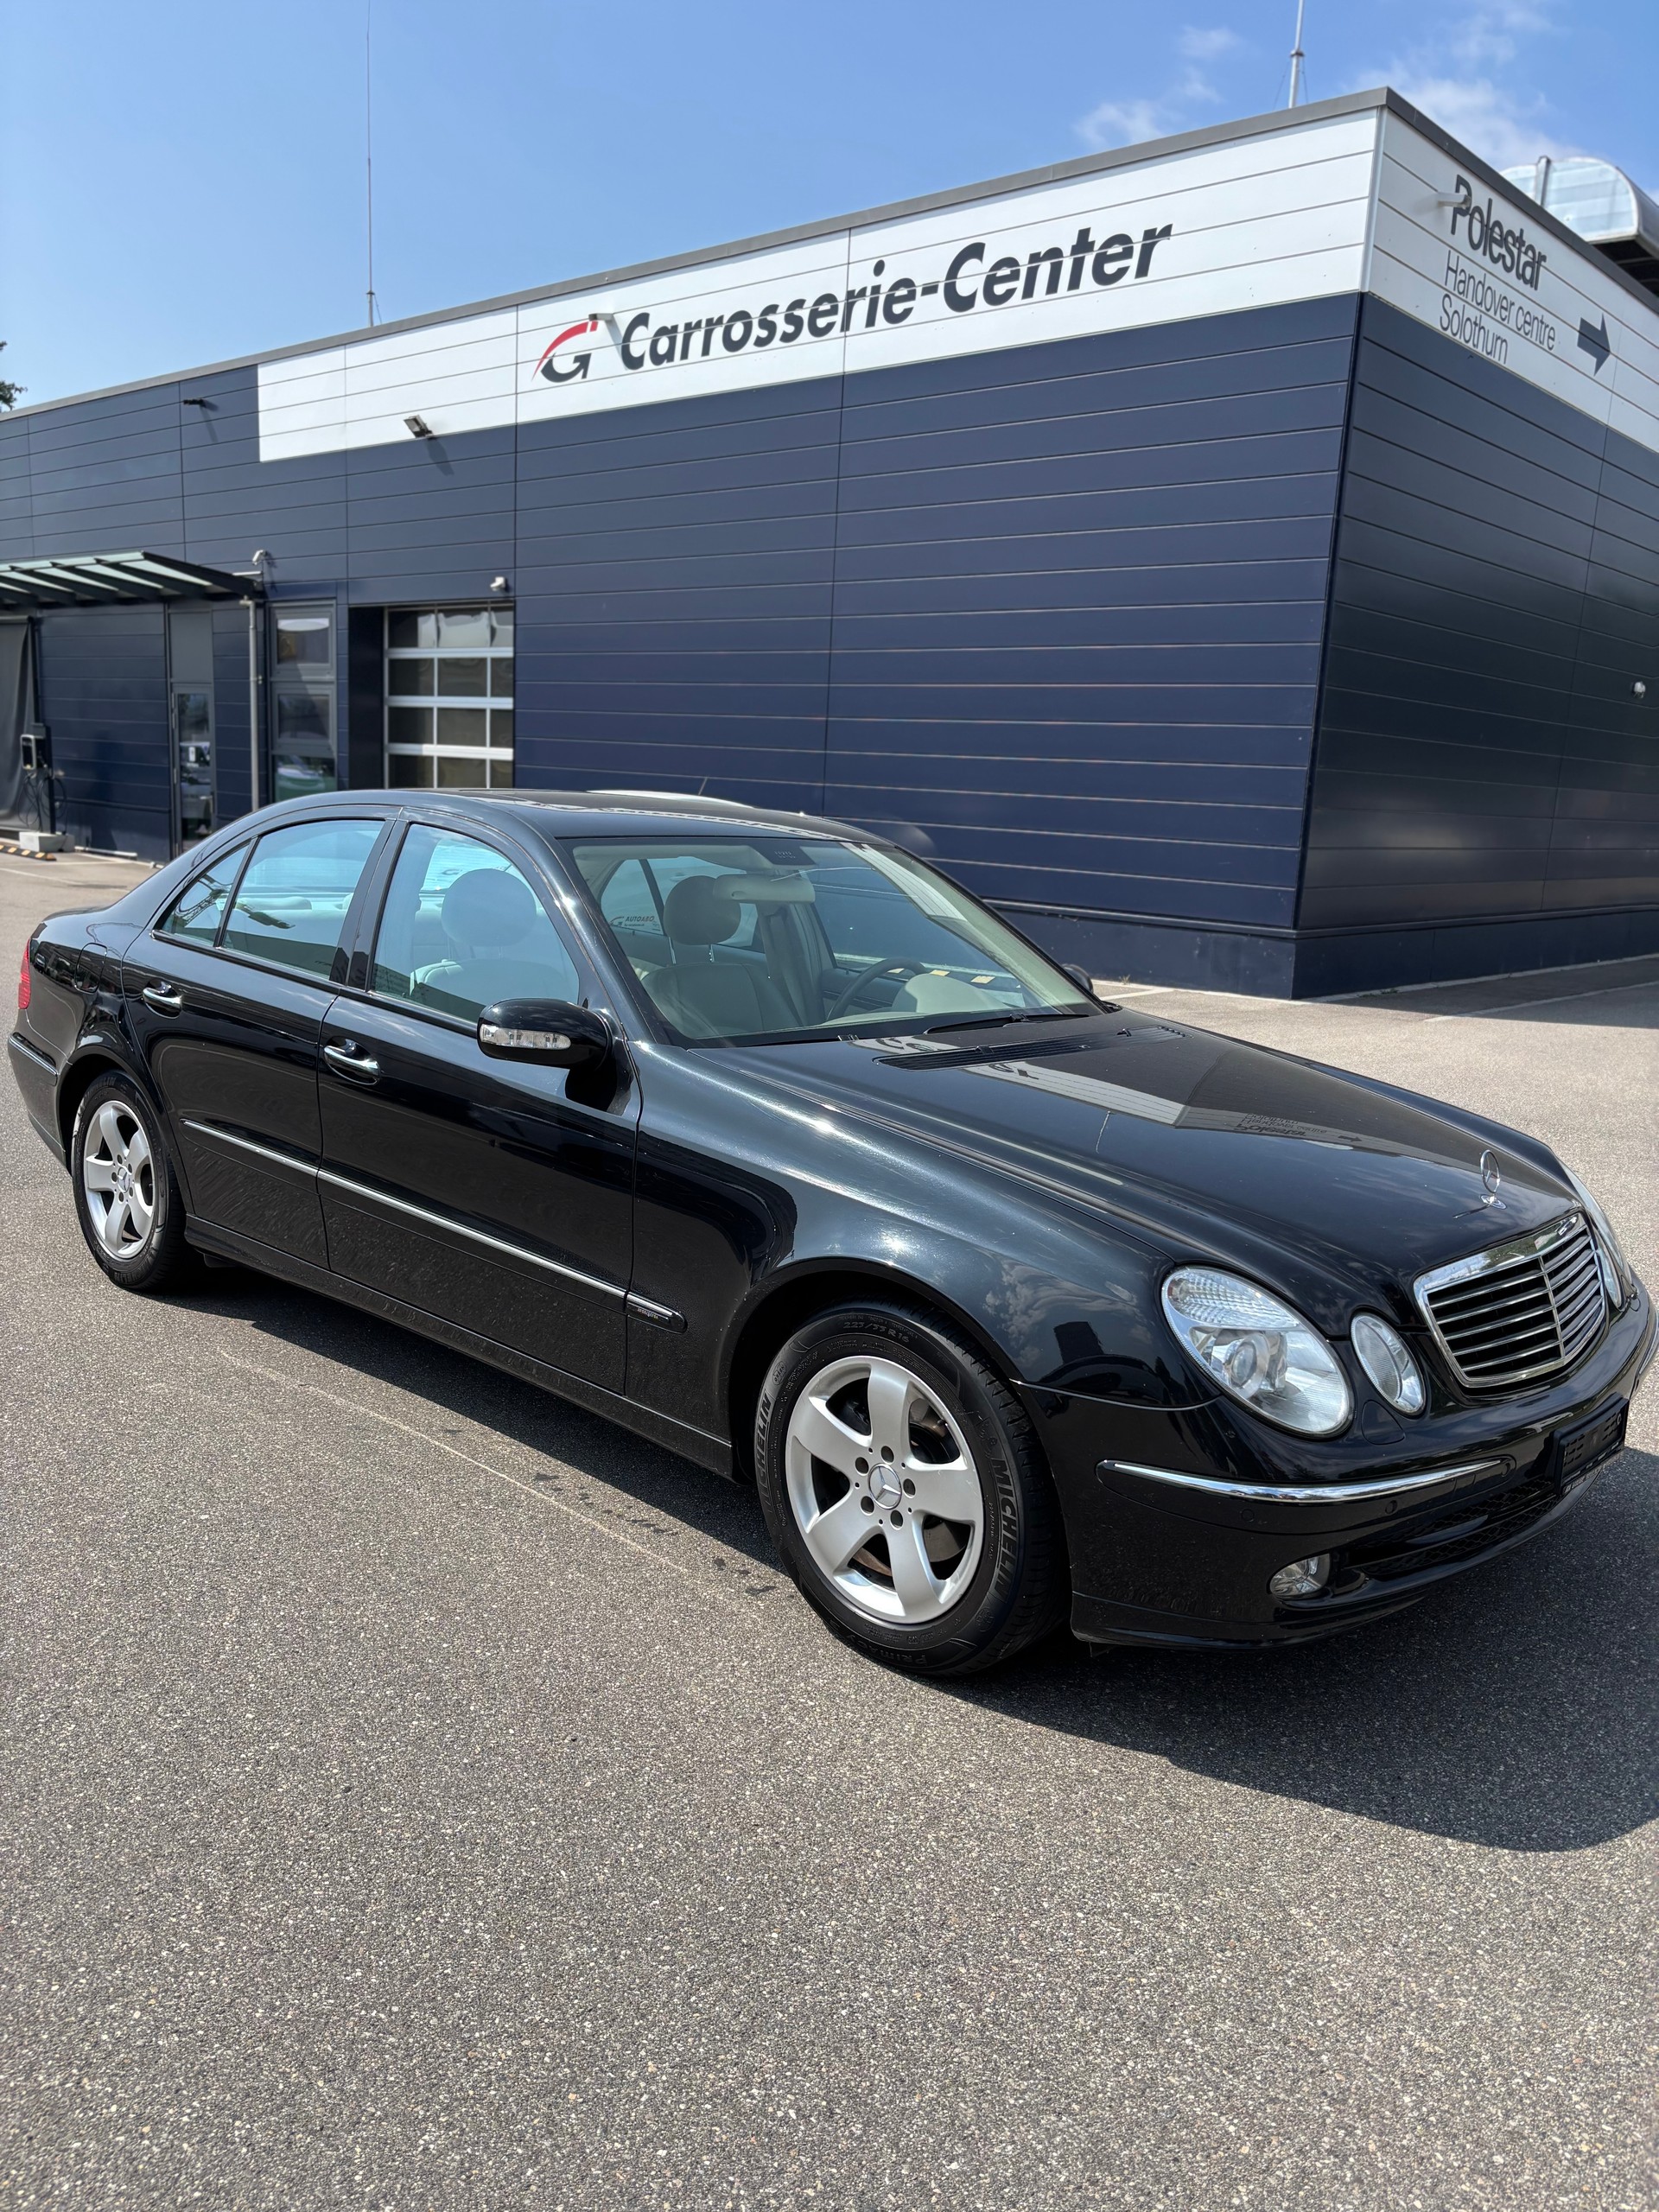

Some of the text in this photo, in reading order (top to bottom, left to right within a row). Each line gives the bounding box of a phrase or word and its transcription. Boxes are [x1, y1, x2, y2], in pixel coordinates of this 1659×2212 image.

[1450, 174, 1547, 290] Polestar
[621, 223, 1173, 371] Carrosserie-Center
[1440, 294, 1509, 365] Solothurn
[1444, 250, 1556, 352] Handover centre
[991, 1458, 1018, 1604] MICHELIN
